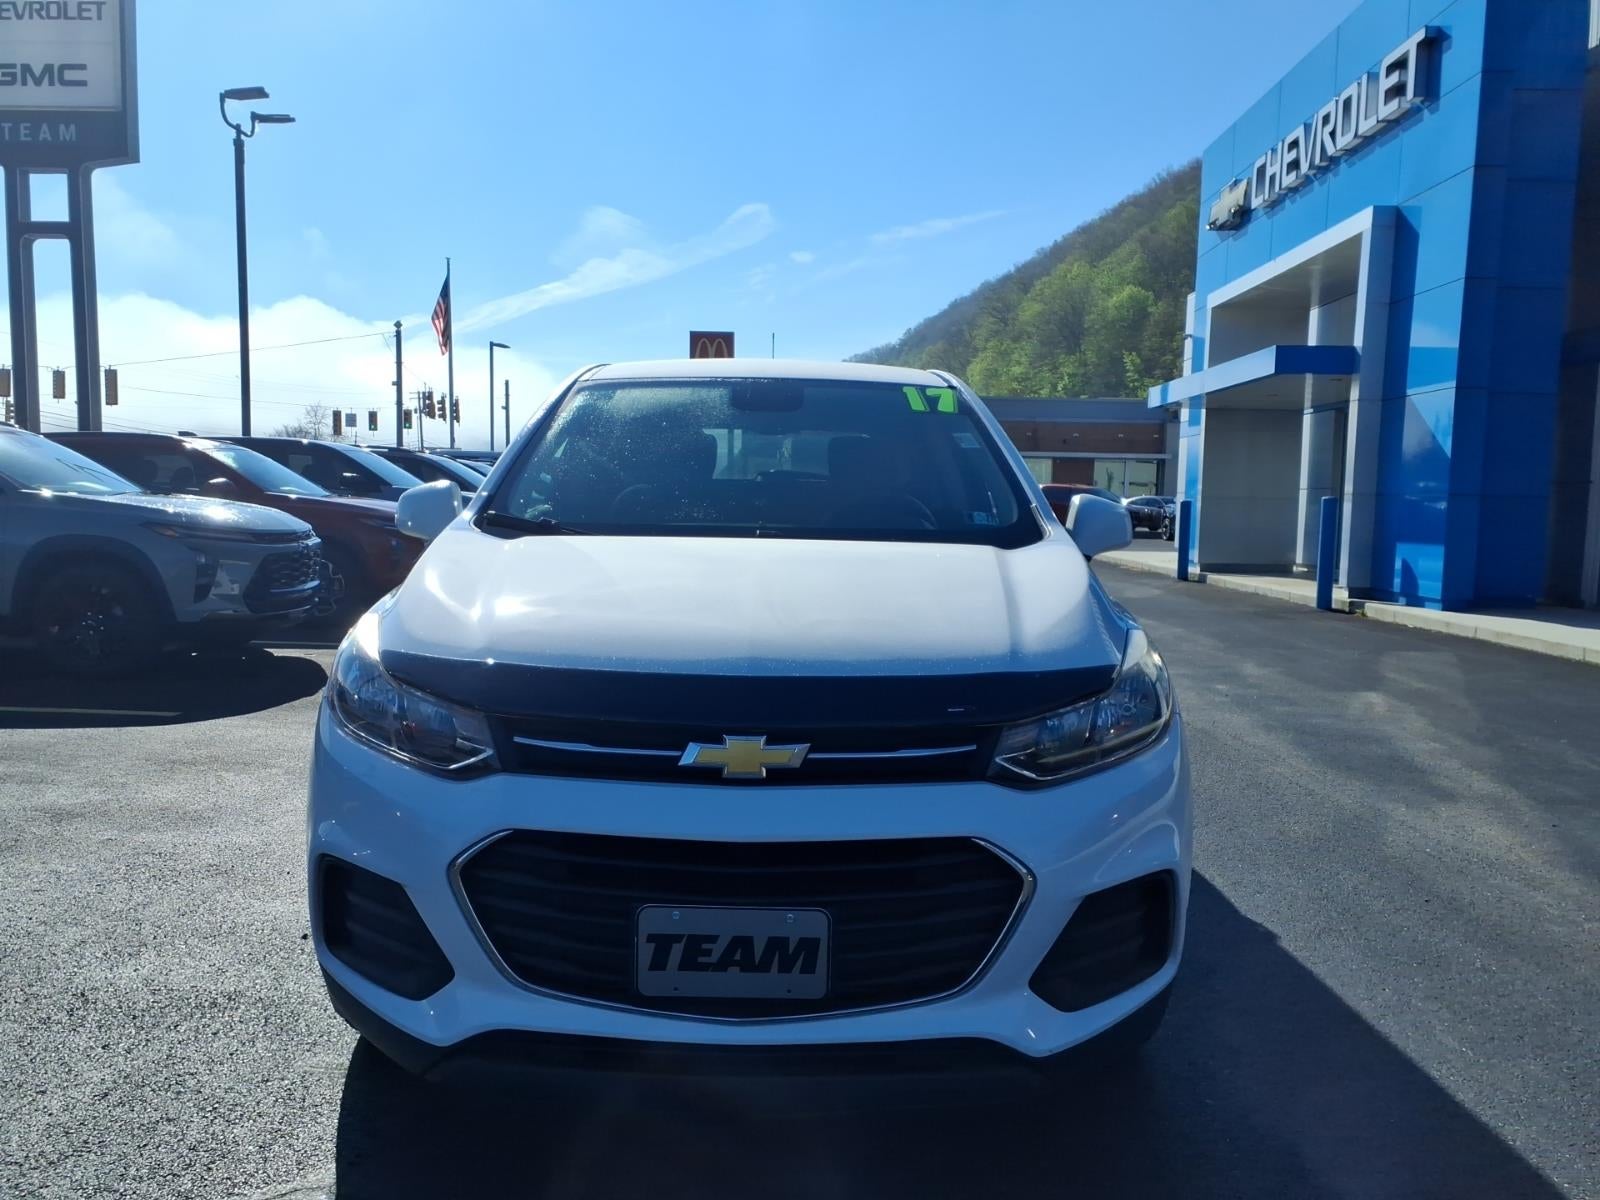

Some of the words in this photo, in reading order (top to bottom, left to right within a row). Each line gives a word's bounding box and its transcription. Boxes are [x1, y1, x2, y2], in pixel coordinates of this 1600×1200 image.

[0, 63, 88, 87] GMC
[1251, 26, 1426, 209] CHEVROLET
[1, 122, 77, 142] TEAM
[902, 386, 958, 413] 17
[646, 933, 821, 975] TEAM
